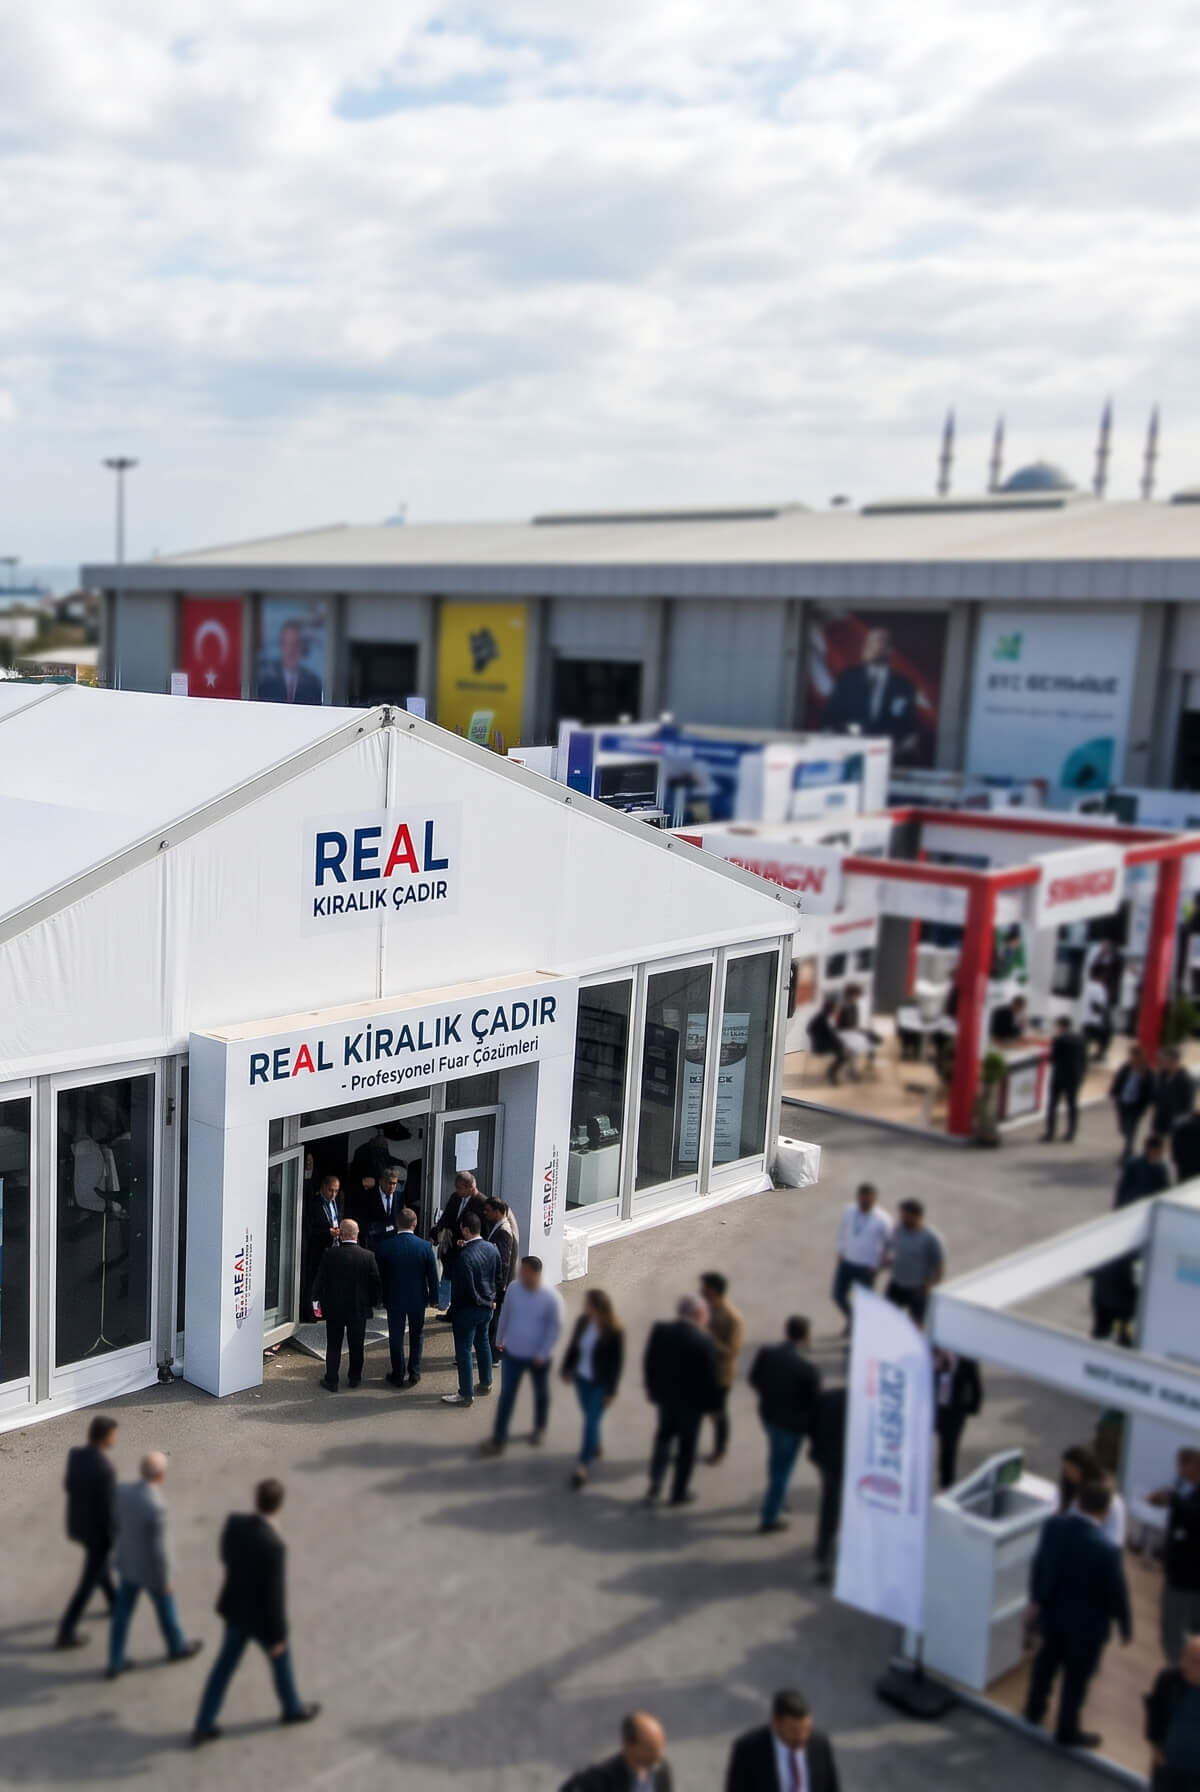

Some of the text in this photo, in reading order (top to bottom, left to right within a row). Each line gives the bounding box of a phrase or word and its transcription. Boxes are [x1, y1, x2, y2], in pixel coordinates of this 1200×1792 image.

[315, 820, 448, 886] REAL
[313, 881, 448, 917] KIRALIK ÇADIR
[249, 996, 557, 1085] REAL KİRALIK ÇADIR
[351, 1059, 435, 1091] Profesyonel
[439, 1054, 470, 1072] Fuar
[473, 1036, 539, 1067] Çözümleri
